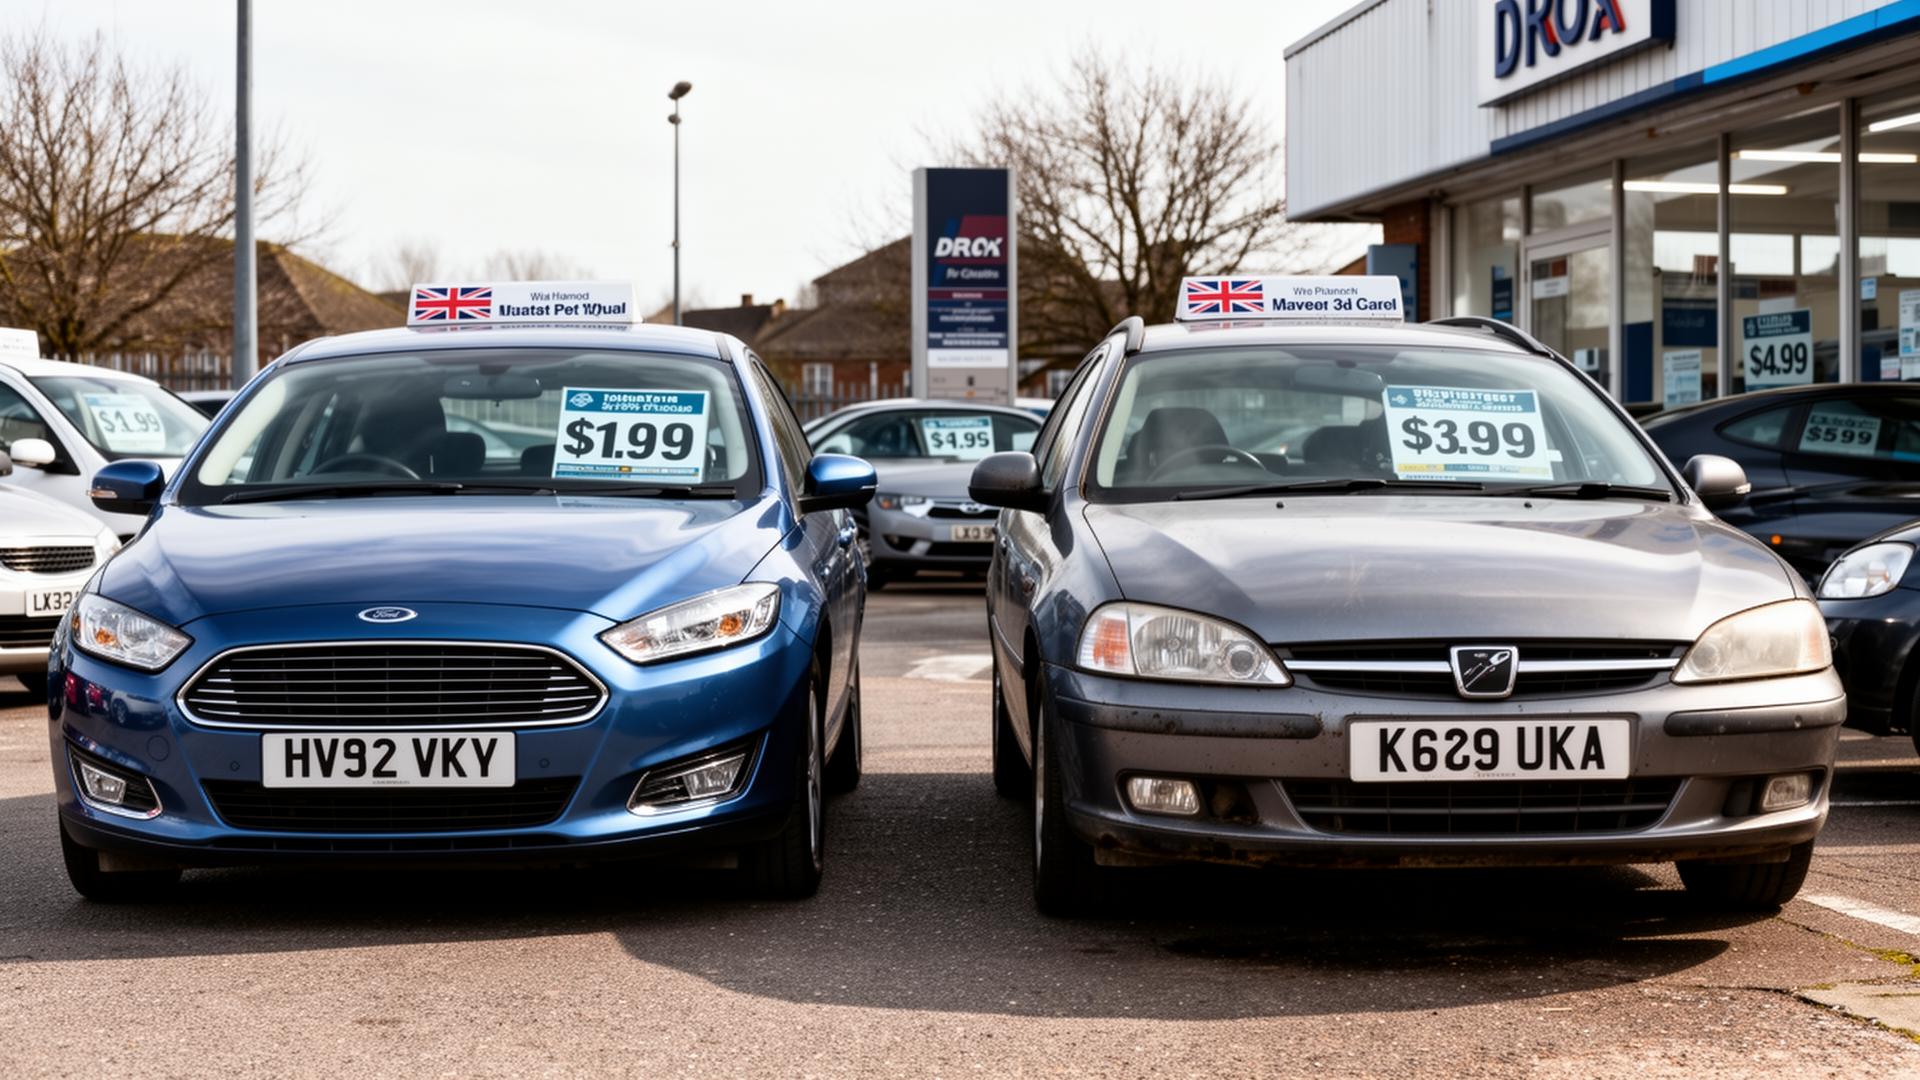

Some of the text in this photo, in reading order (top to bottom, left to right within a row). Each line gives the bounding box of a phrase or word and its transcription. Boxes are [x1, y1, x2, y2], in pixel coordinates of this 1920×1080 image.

[554, 303, 579, 315] Pet
[1750, 343, 1807, 378] $4.99
[99, 410, 161, 433] $1.99
[563, 417, 694, 461] $1.99
[1402, 416, 1535, 459] $3.99
[33, 591, 79, 611] LX32
[285, 738, 498, 778] HV92 VKY
[1517, 726, 1606, 771] UKA
